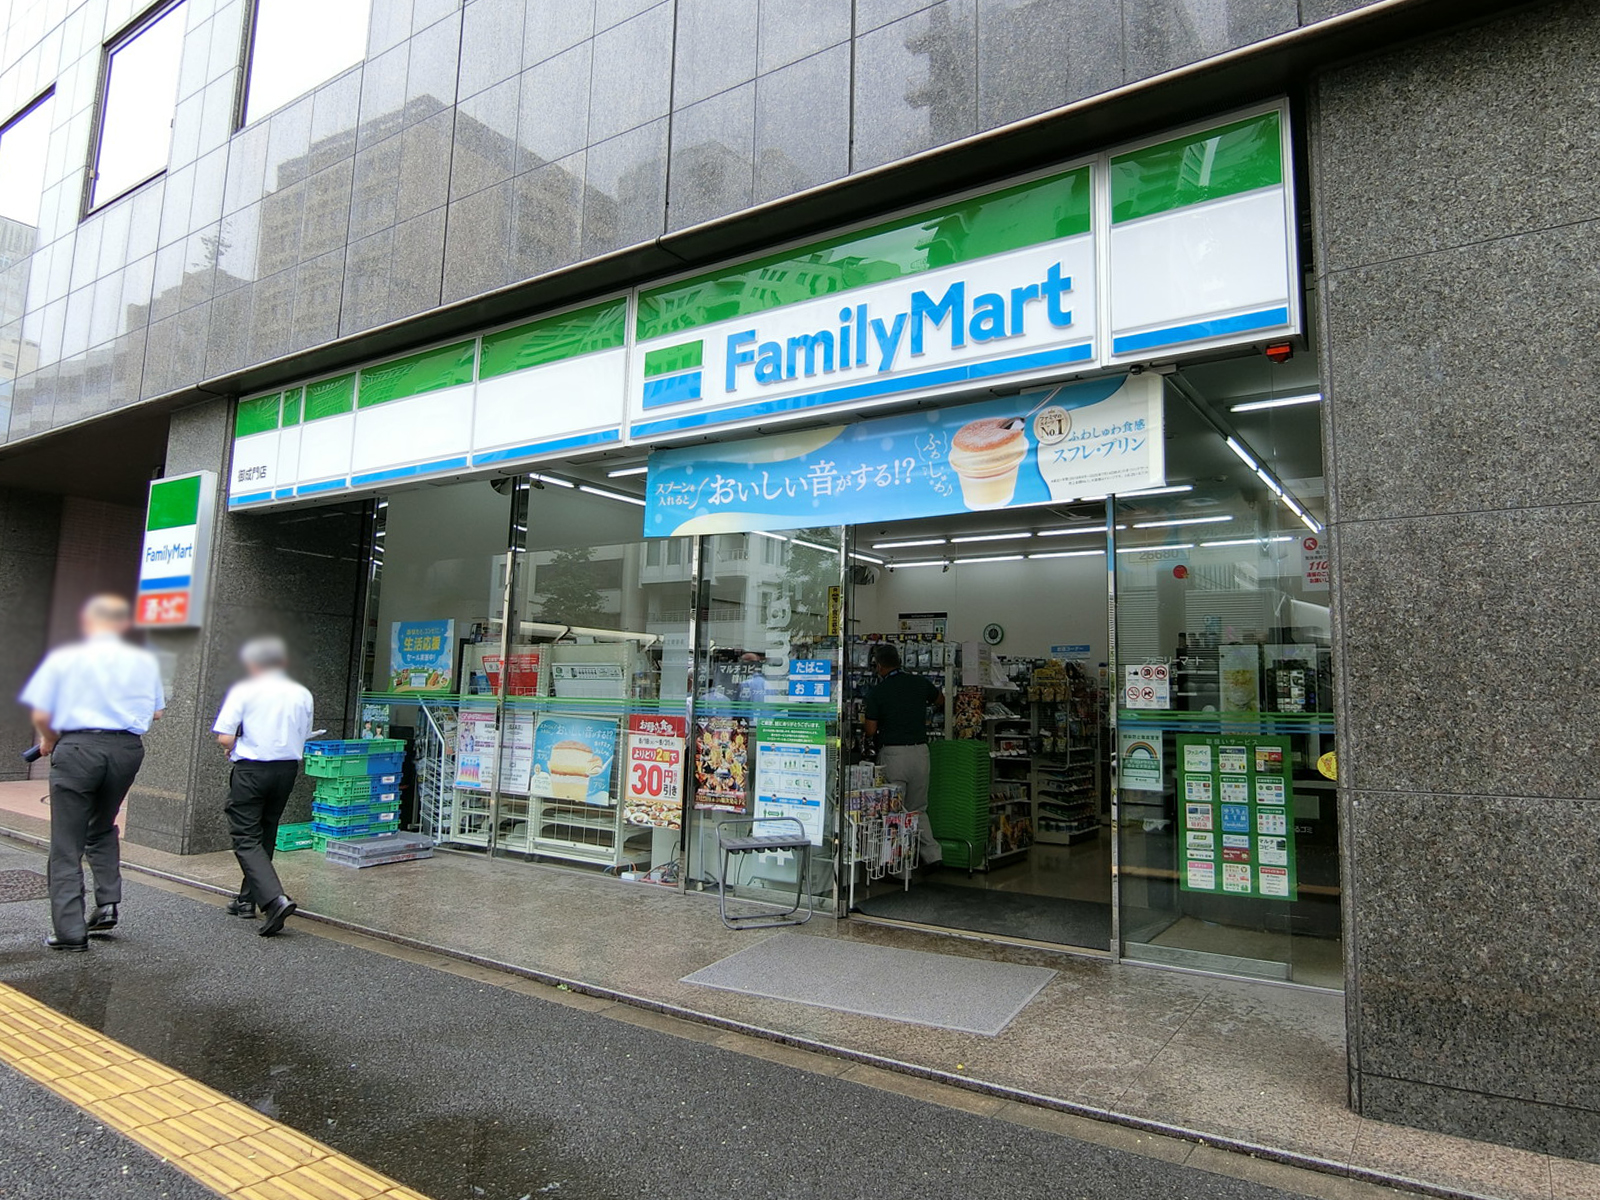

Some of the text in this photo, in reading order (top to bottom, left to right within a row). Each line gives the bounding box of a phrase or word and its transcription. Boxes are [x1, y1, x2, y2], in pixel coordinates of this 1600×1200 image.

[725, 261, 1074, 394] FamilyMart
[1068, 418, 1146, 441] ふわしゅわ食感
[1053, 436, 1147, 464] スフレ・プリン
[238, 465, 267, 482] 御成門店
[655, 481, 695, 495] スプーンを
[658, 495, 690, 506] 入れると
[146, 542, 193, 564] FamilyMart
[796, 661, 825, 674] たばこ
[1141, 656, 1204, 666] ファミリーマート
[720, 664, 763, 674] マルチコピー
